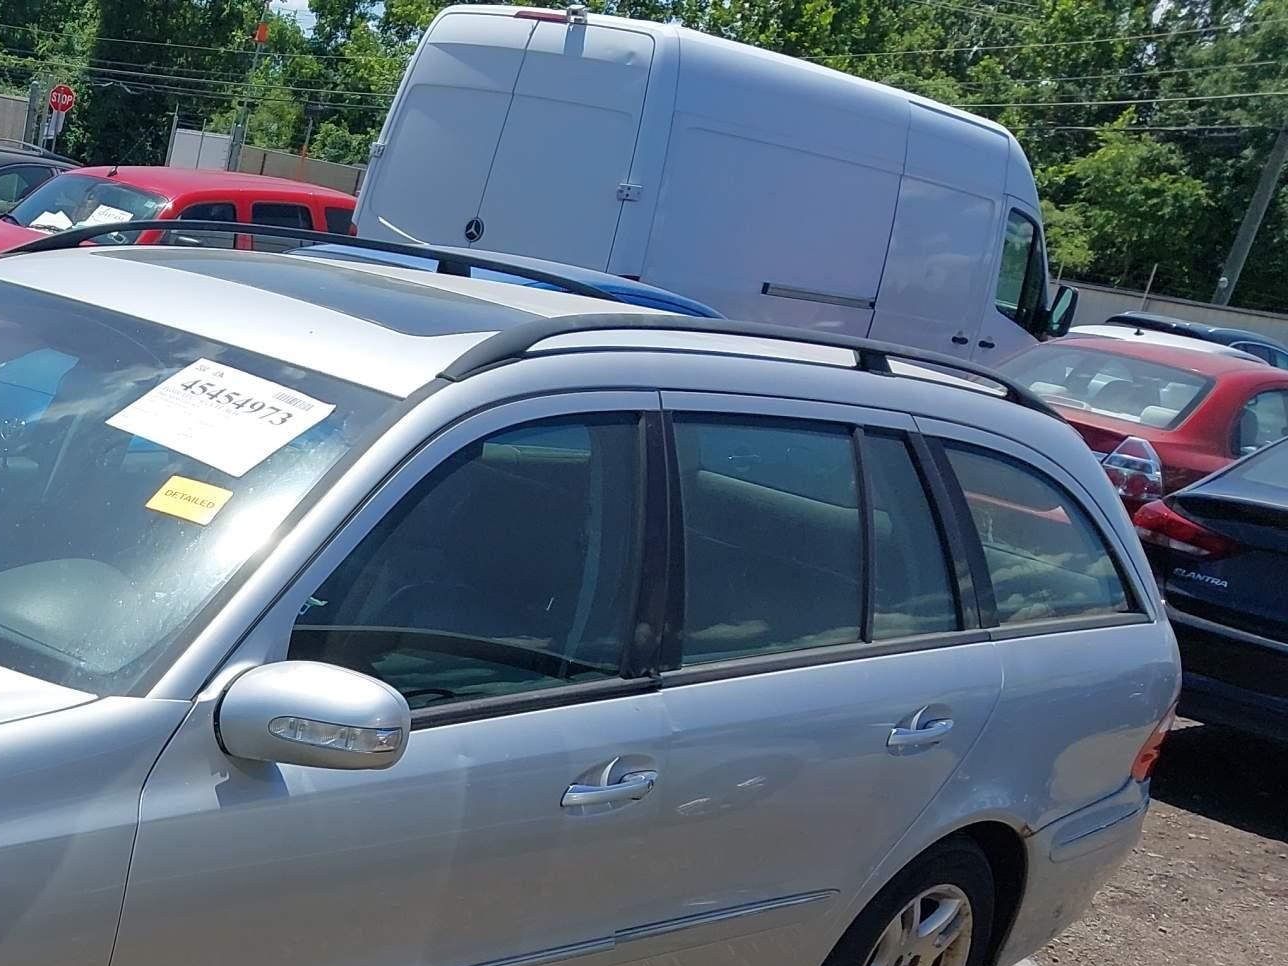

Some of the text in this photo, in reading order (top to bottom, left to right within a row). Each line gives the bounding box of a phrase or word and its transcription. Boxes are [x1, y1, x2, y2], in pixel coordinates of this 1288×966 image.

[51, 91, 73, 105] STOP
[180, 379, 293, 426] 45454973
[164, 489, 216, 509] DETAILED
[1173, 568, 1228, 588] ELANTRA
